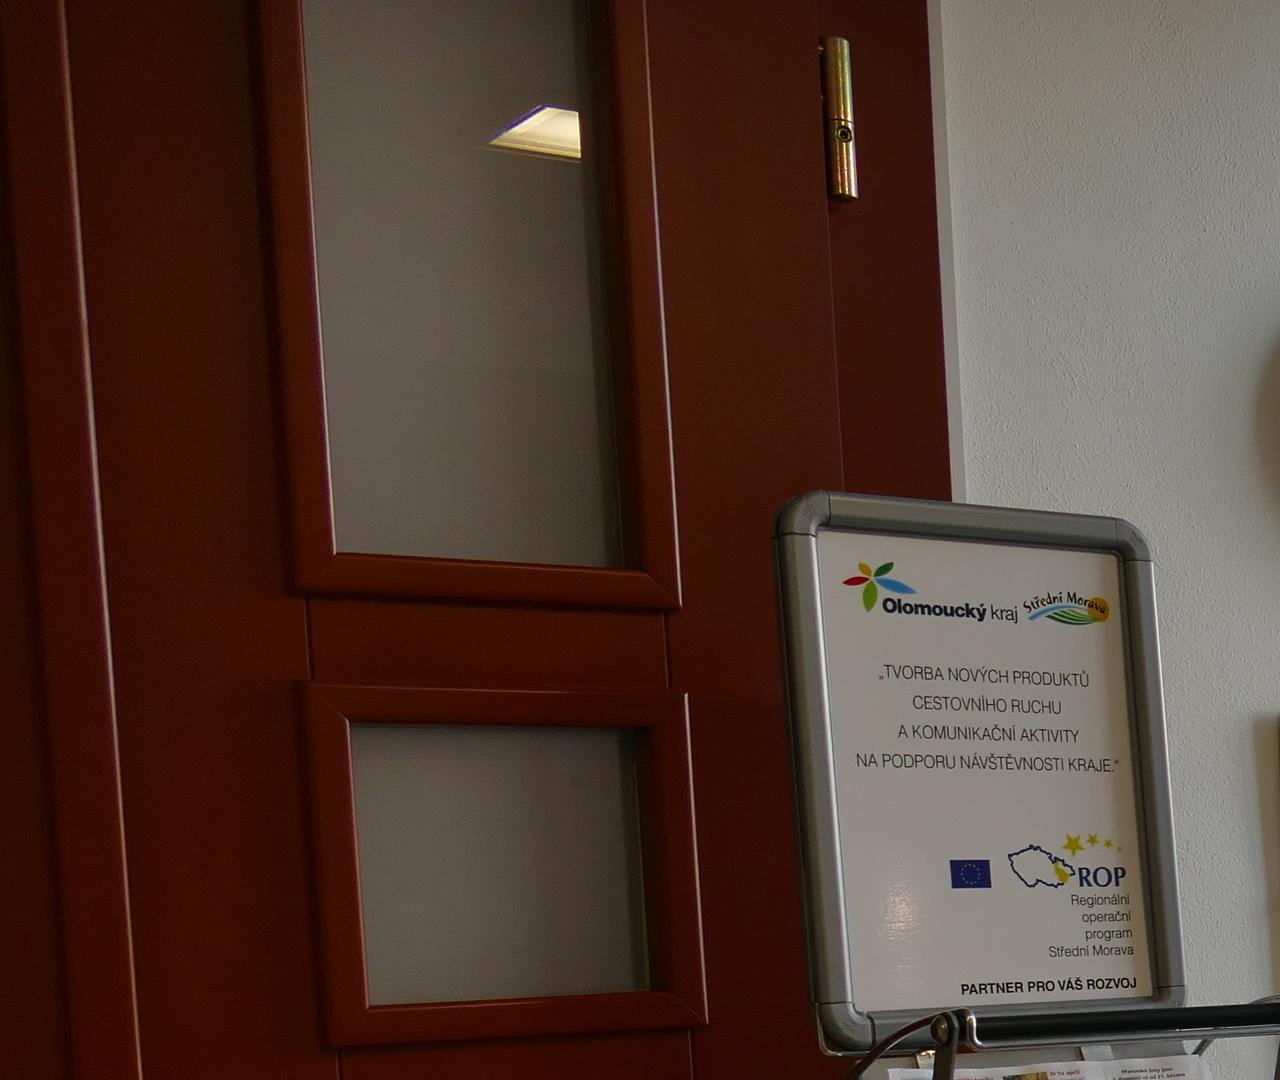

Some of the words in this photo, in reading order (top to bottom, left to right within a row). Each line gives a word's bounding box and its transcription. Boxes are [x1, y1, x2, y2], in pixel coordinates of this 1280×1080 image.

[882, 597, 986, 621] Olomoucký
[990, 605, 1018, 623] kraj
[1023, 592, 1063, 614] Střední
[1066, 592, 1106, 615] Morava
[948, 666, 1009, 684] NOVÝCH
[1013, 670, 1089, 687] PRODUKTŮ
[912, 695, 1007, 713] CESTOVNÍHO
[1011, 700, 1061, 714] RUCHU
[898, 724, 908, 738] A
[912, 724, 1016, 741] KOMUNIKAČNÍ
[1020, 729, 1079, 743] AKTIVITY
[856, 754, 878, 768] NA
[882, 754, 956, 769] PODPORU
[960, 752, 1064, 771] NÁVŠTĚVNOSTI
[1078, 867, 1126, 887] ROP
[1071, 894, 1130, 908] Regionální
[1082, 911, 1131, 924] operační
[1085, 929, 1132, 941] program
[1049, 945, 1089, 957] Střední
[1092, 945, 1134, 956] Morava
[961, 981, 1023, 995] PARTNER
[1028, 980, 1055, 992] PRO
[1058, 977, 1083, 991] VÁŠ
[1087, 977, 1136, 990] ROZVOJ
